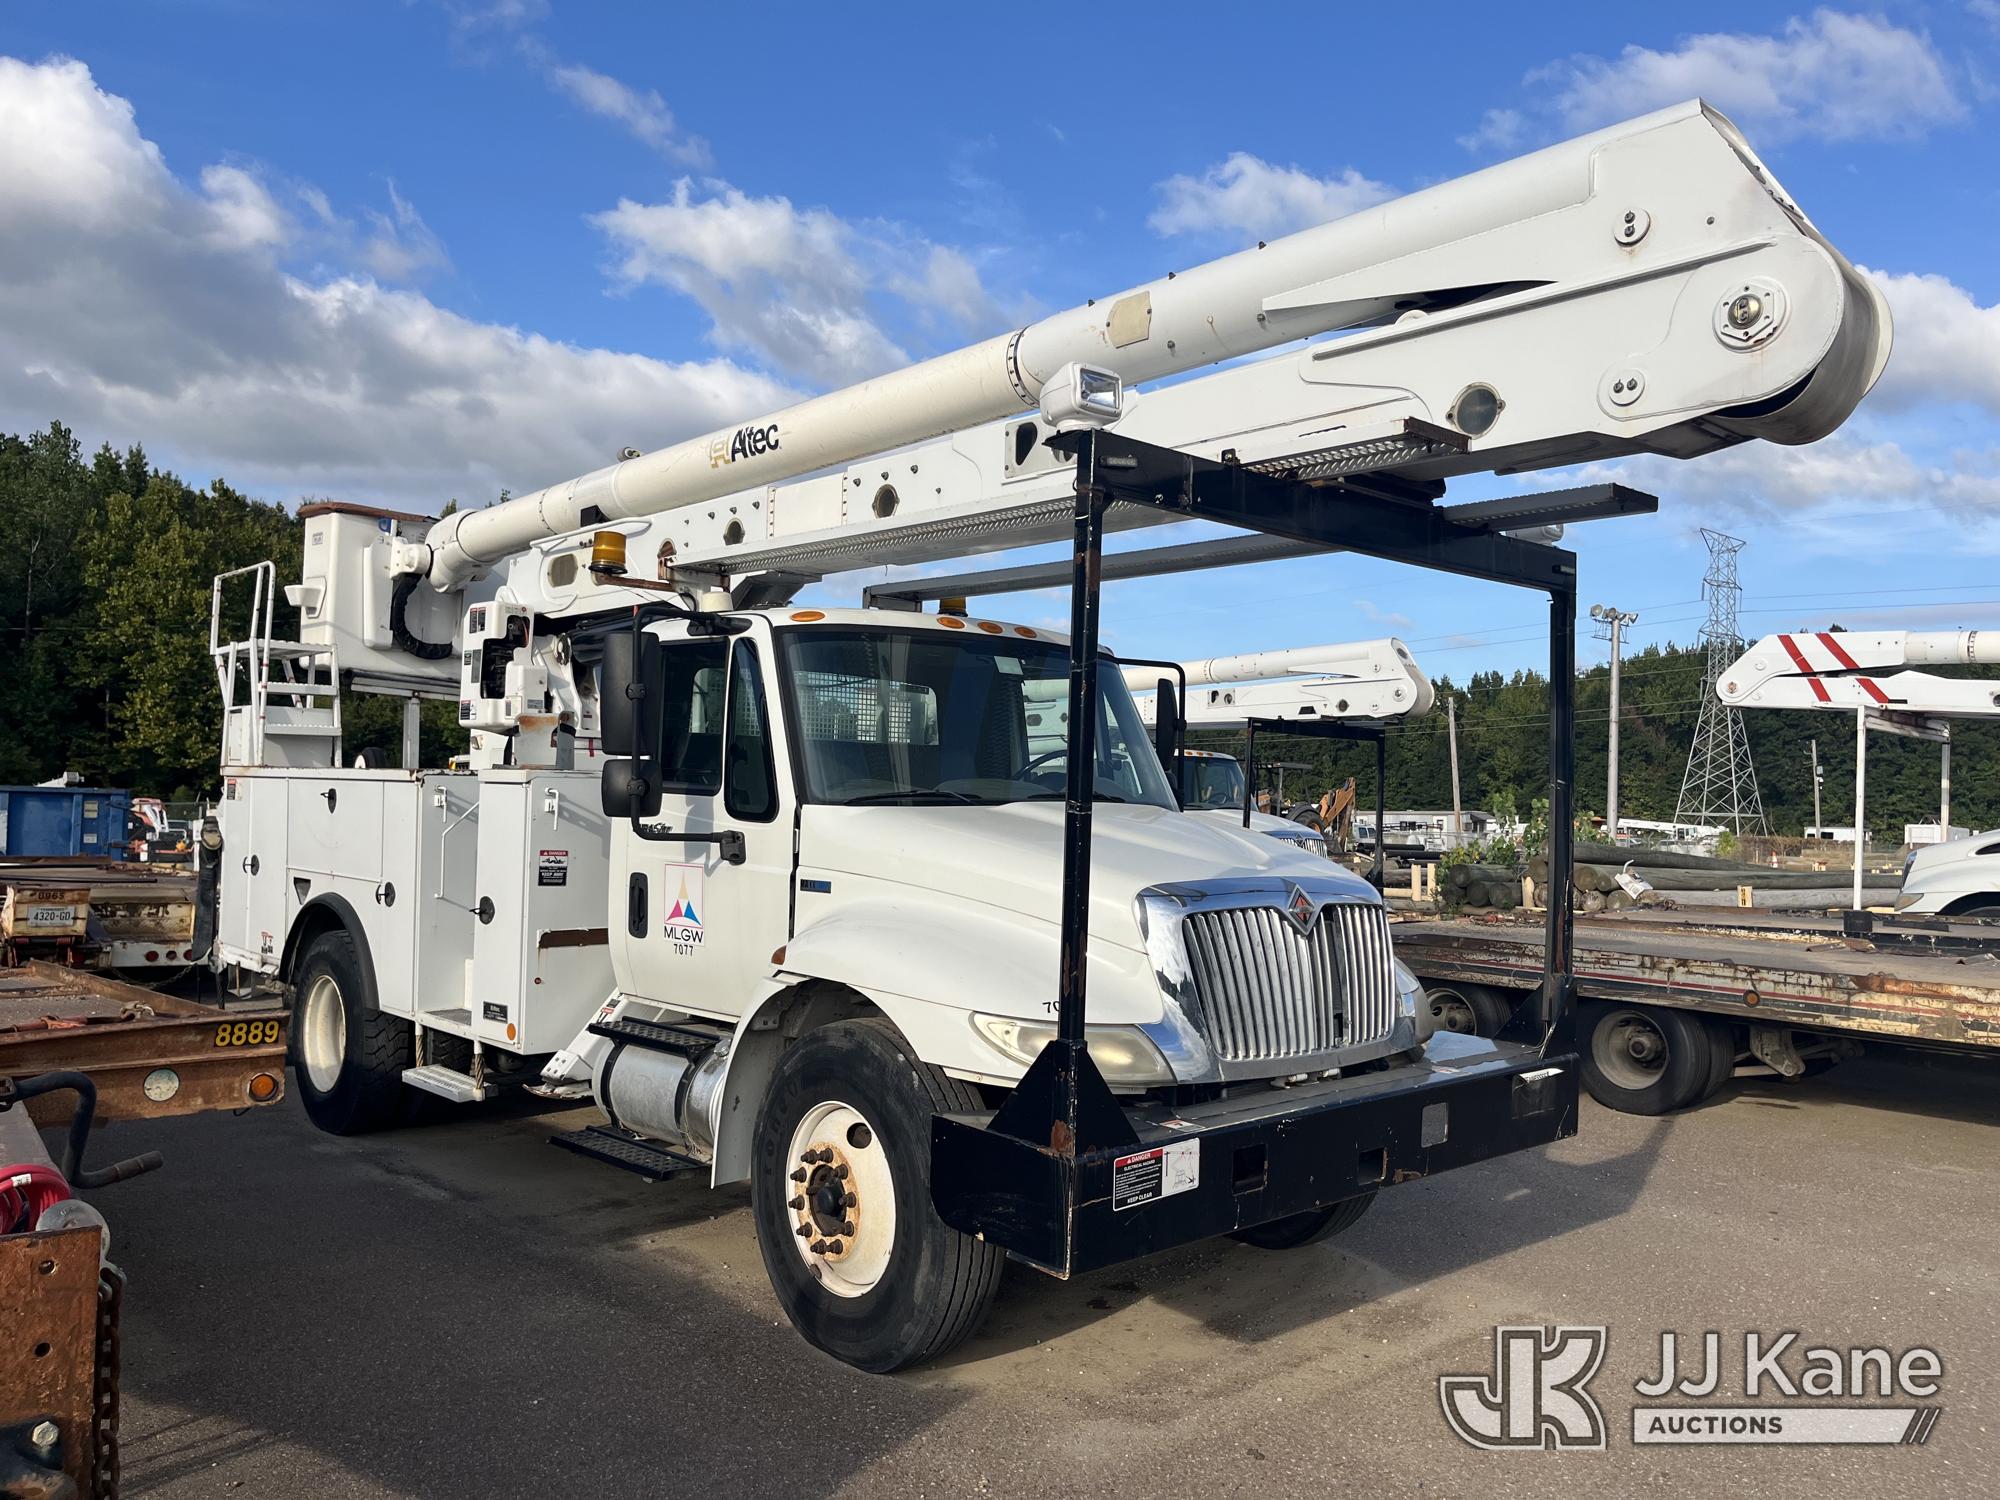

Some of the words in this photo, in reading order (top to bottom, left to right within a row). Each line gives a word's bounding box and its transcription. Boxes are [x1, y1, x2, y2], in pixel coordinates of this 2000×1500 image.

[731, 424, 780, 463] Altec
[33, 911, 71, 921] 4320-GD
[664, 925, 704, 943] MLGW
[673, 943, 694, 957] 7077
[214, 1020, 280, 1047] 8889
[1131, 1152, 1151, 1163] DANGER
[1127, 1195, 1139, 1204] KEEP
[1138, 1191, 1153, 1201] CLEAR
